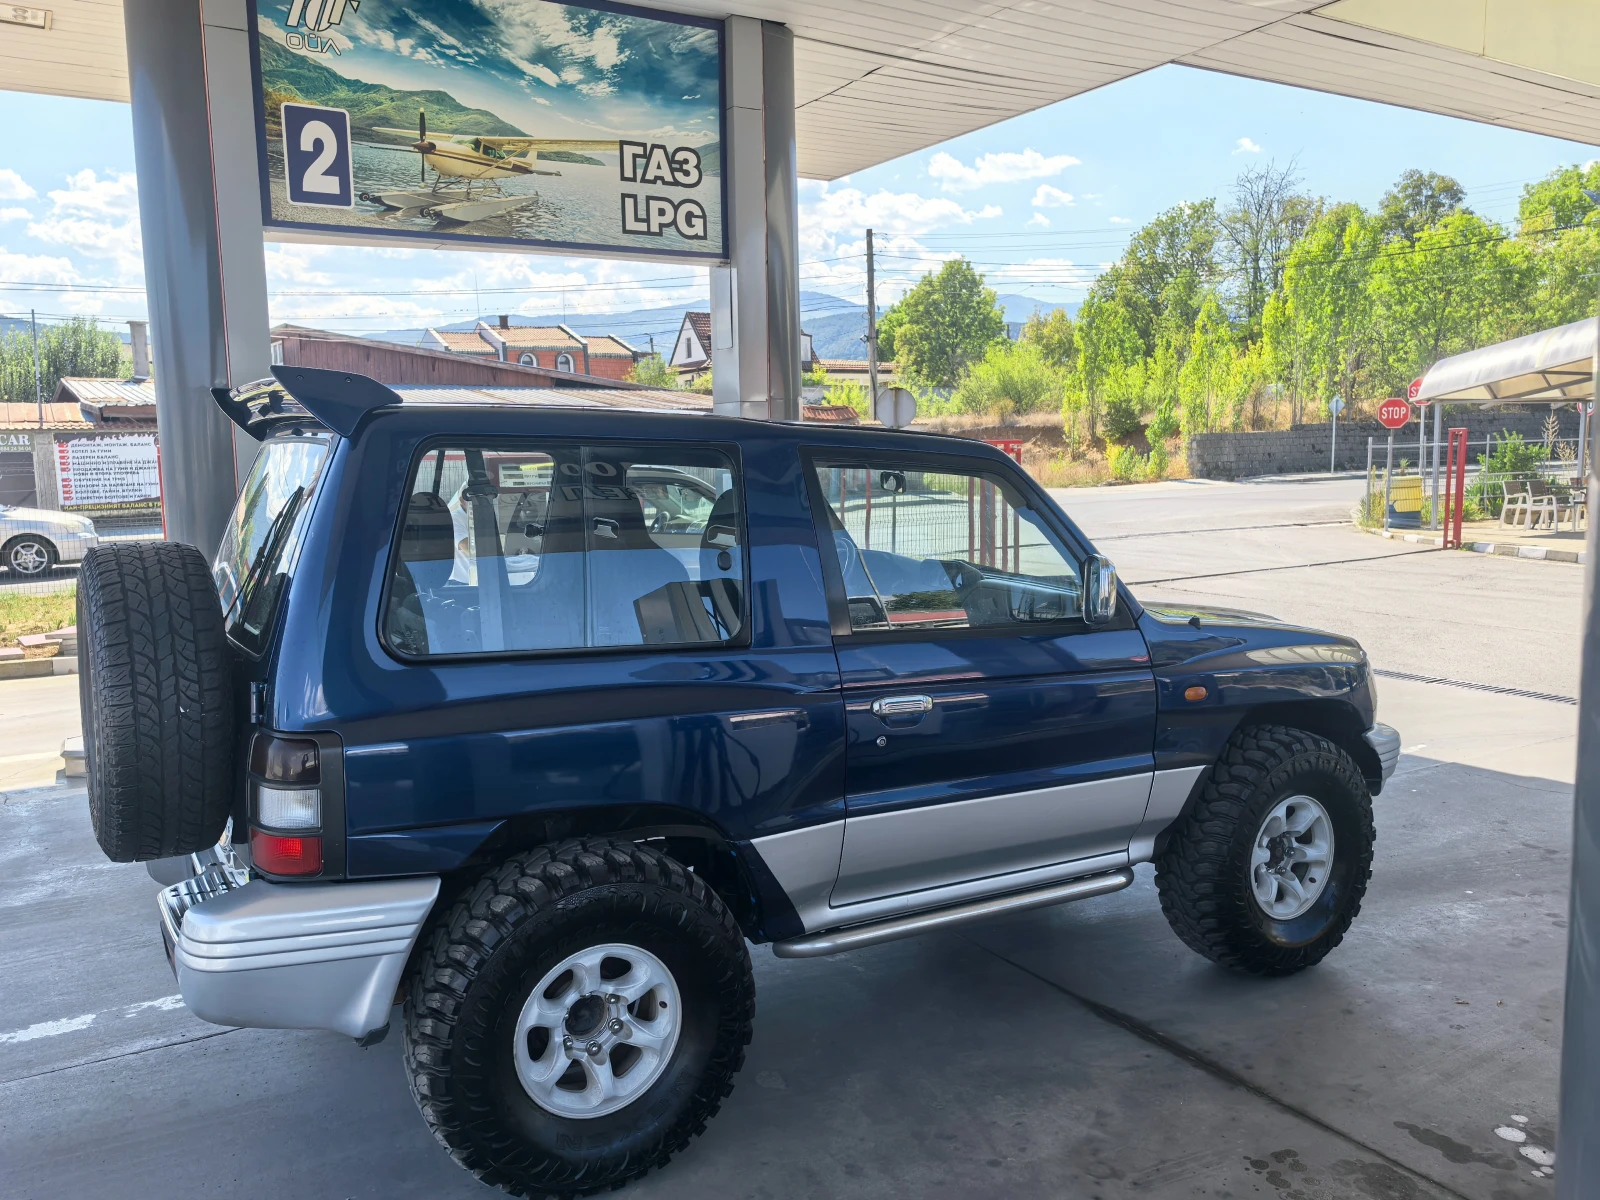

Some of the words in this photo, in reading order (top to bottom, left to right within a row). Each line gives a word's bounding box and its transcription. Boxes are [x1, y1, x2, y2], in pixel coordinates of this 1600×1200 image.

[300, 120, 340, 194] 2
[619, 140, 702, 188] ГАЗ
[621, 193, 707, 240] LPG
[1381, 406, 1407, 419] STOP
[0, 434, 31, 446] CAR
